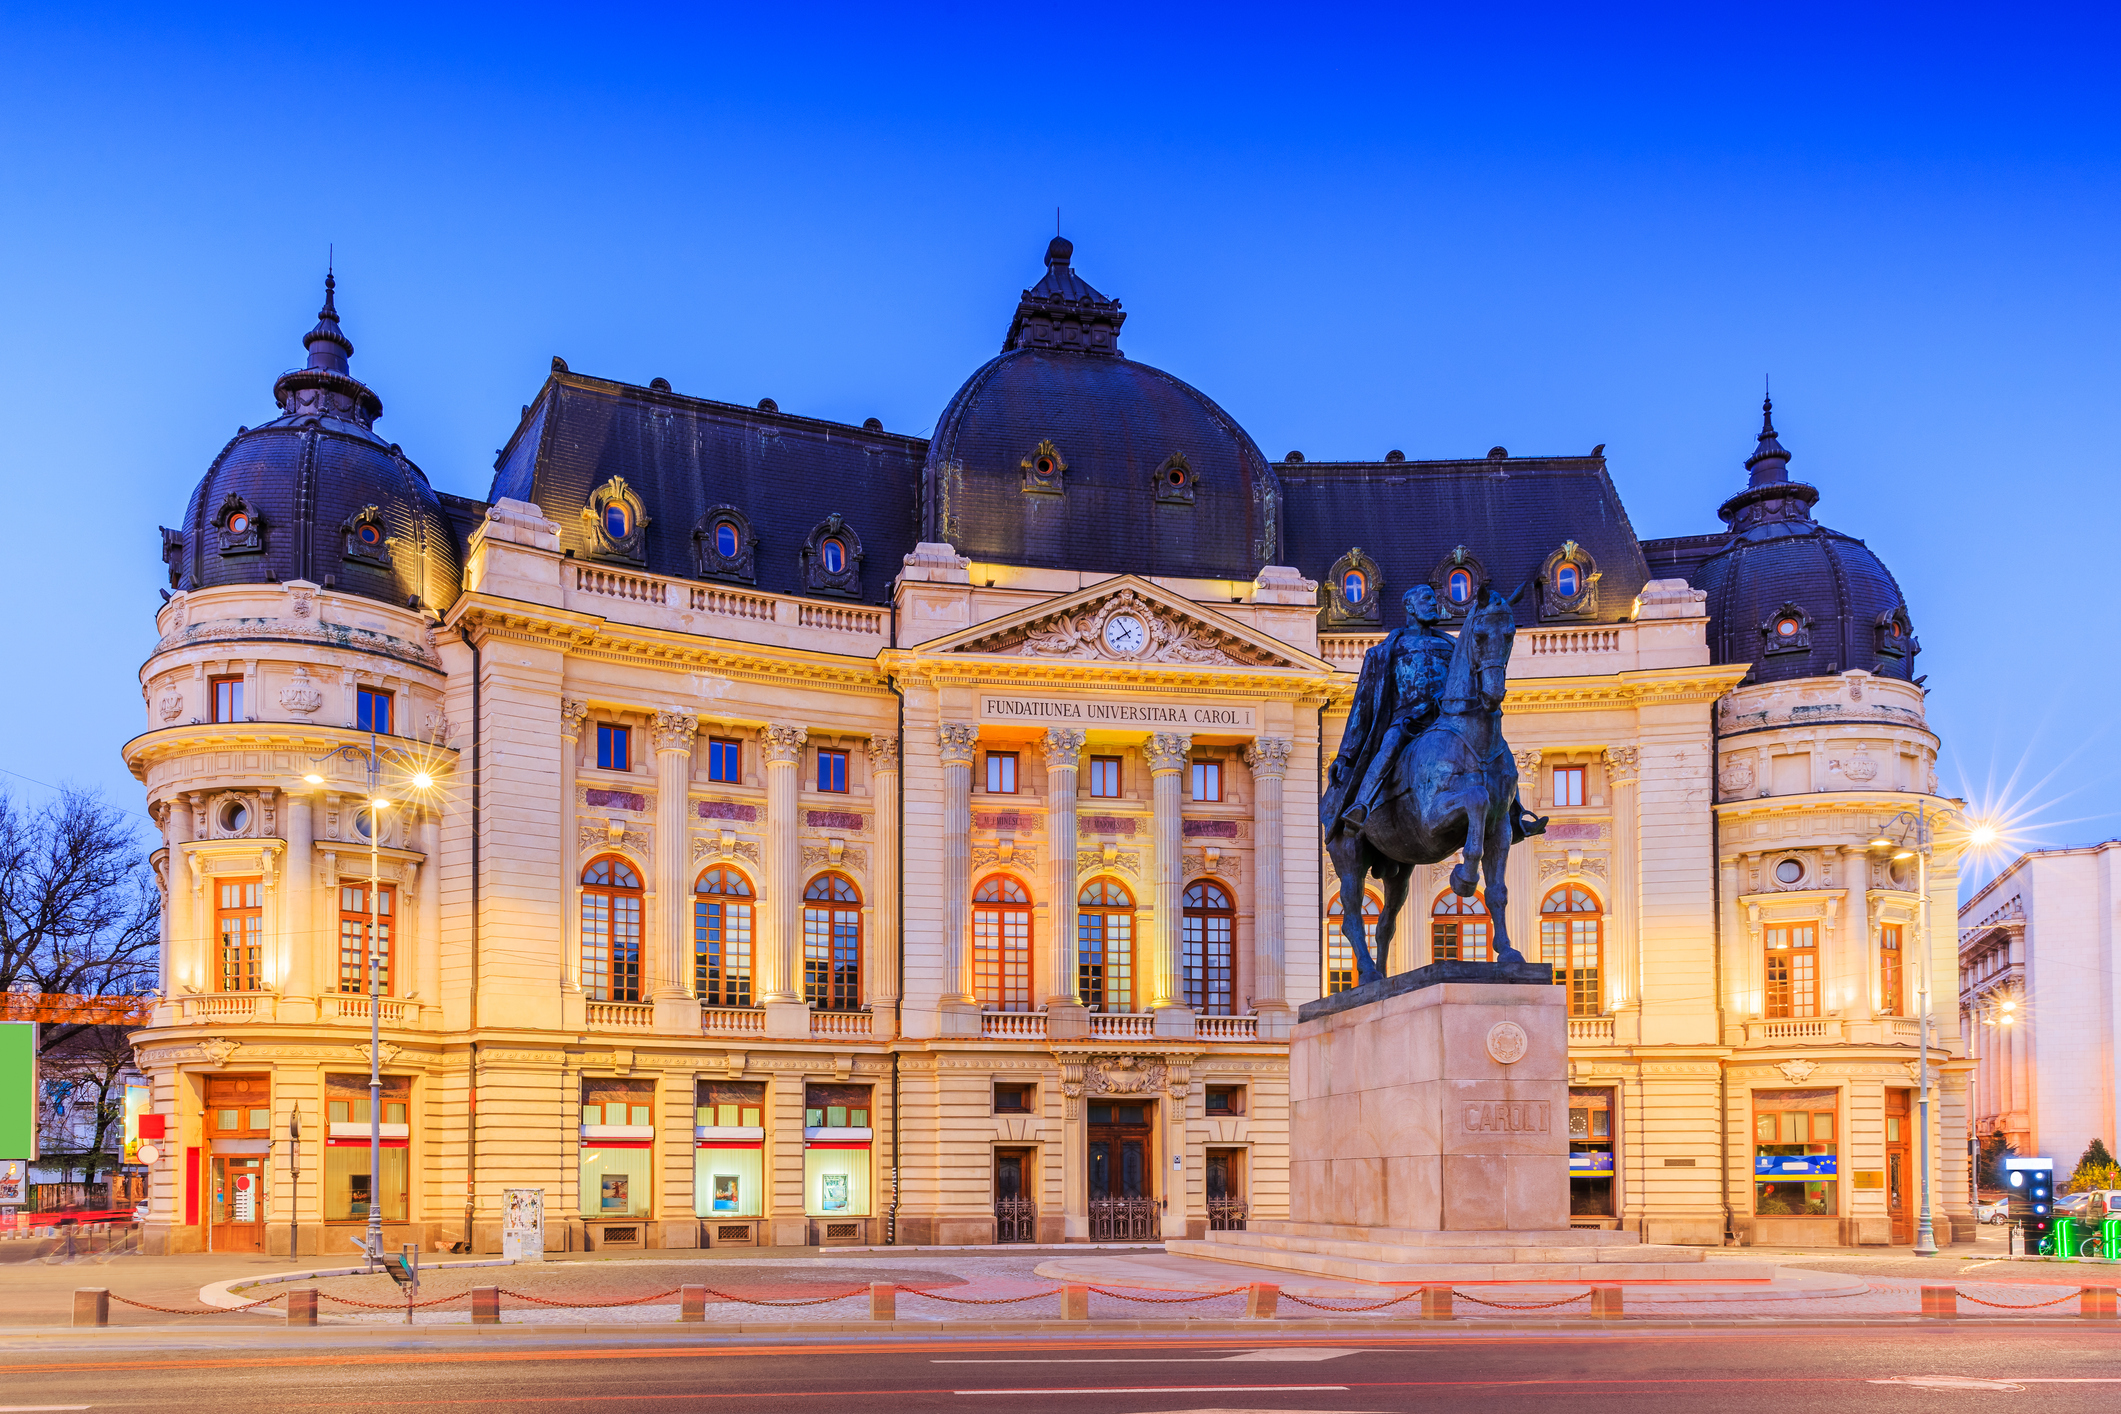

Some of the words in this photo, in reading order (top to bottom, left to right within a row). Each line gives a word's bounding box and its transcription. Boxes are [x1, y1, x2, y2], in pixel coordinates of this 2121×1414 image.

[987, 700, 1081, 717] FUNDATIUNEA
[1087, 704, 1187, 722] UNIVERSITARA
[1194, 709, 1239, 724] CAROL
[1245, 711, 1250, 724] I
[1464, 1104, 1535, 1131] CAROL
[1538, 1104, 1548, 1131] I
